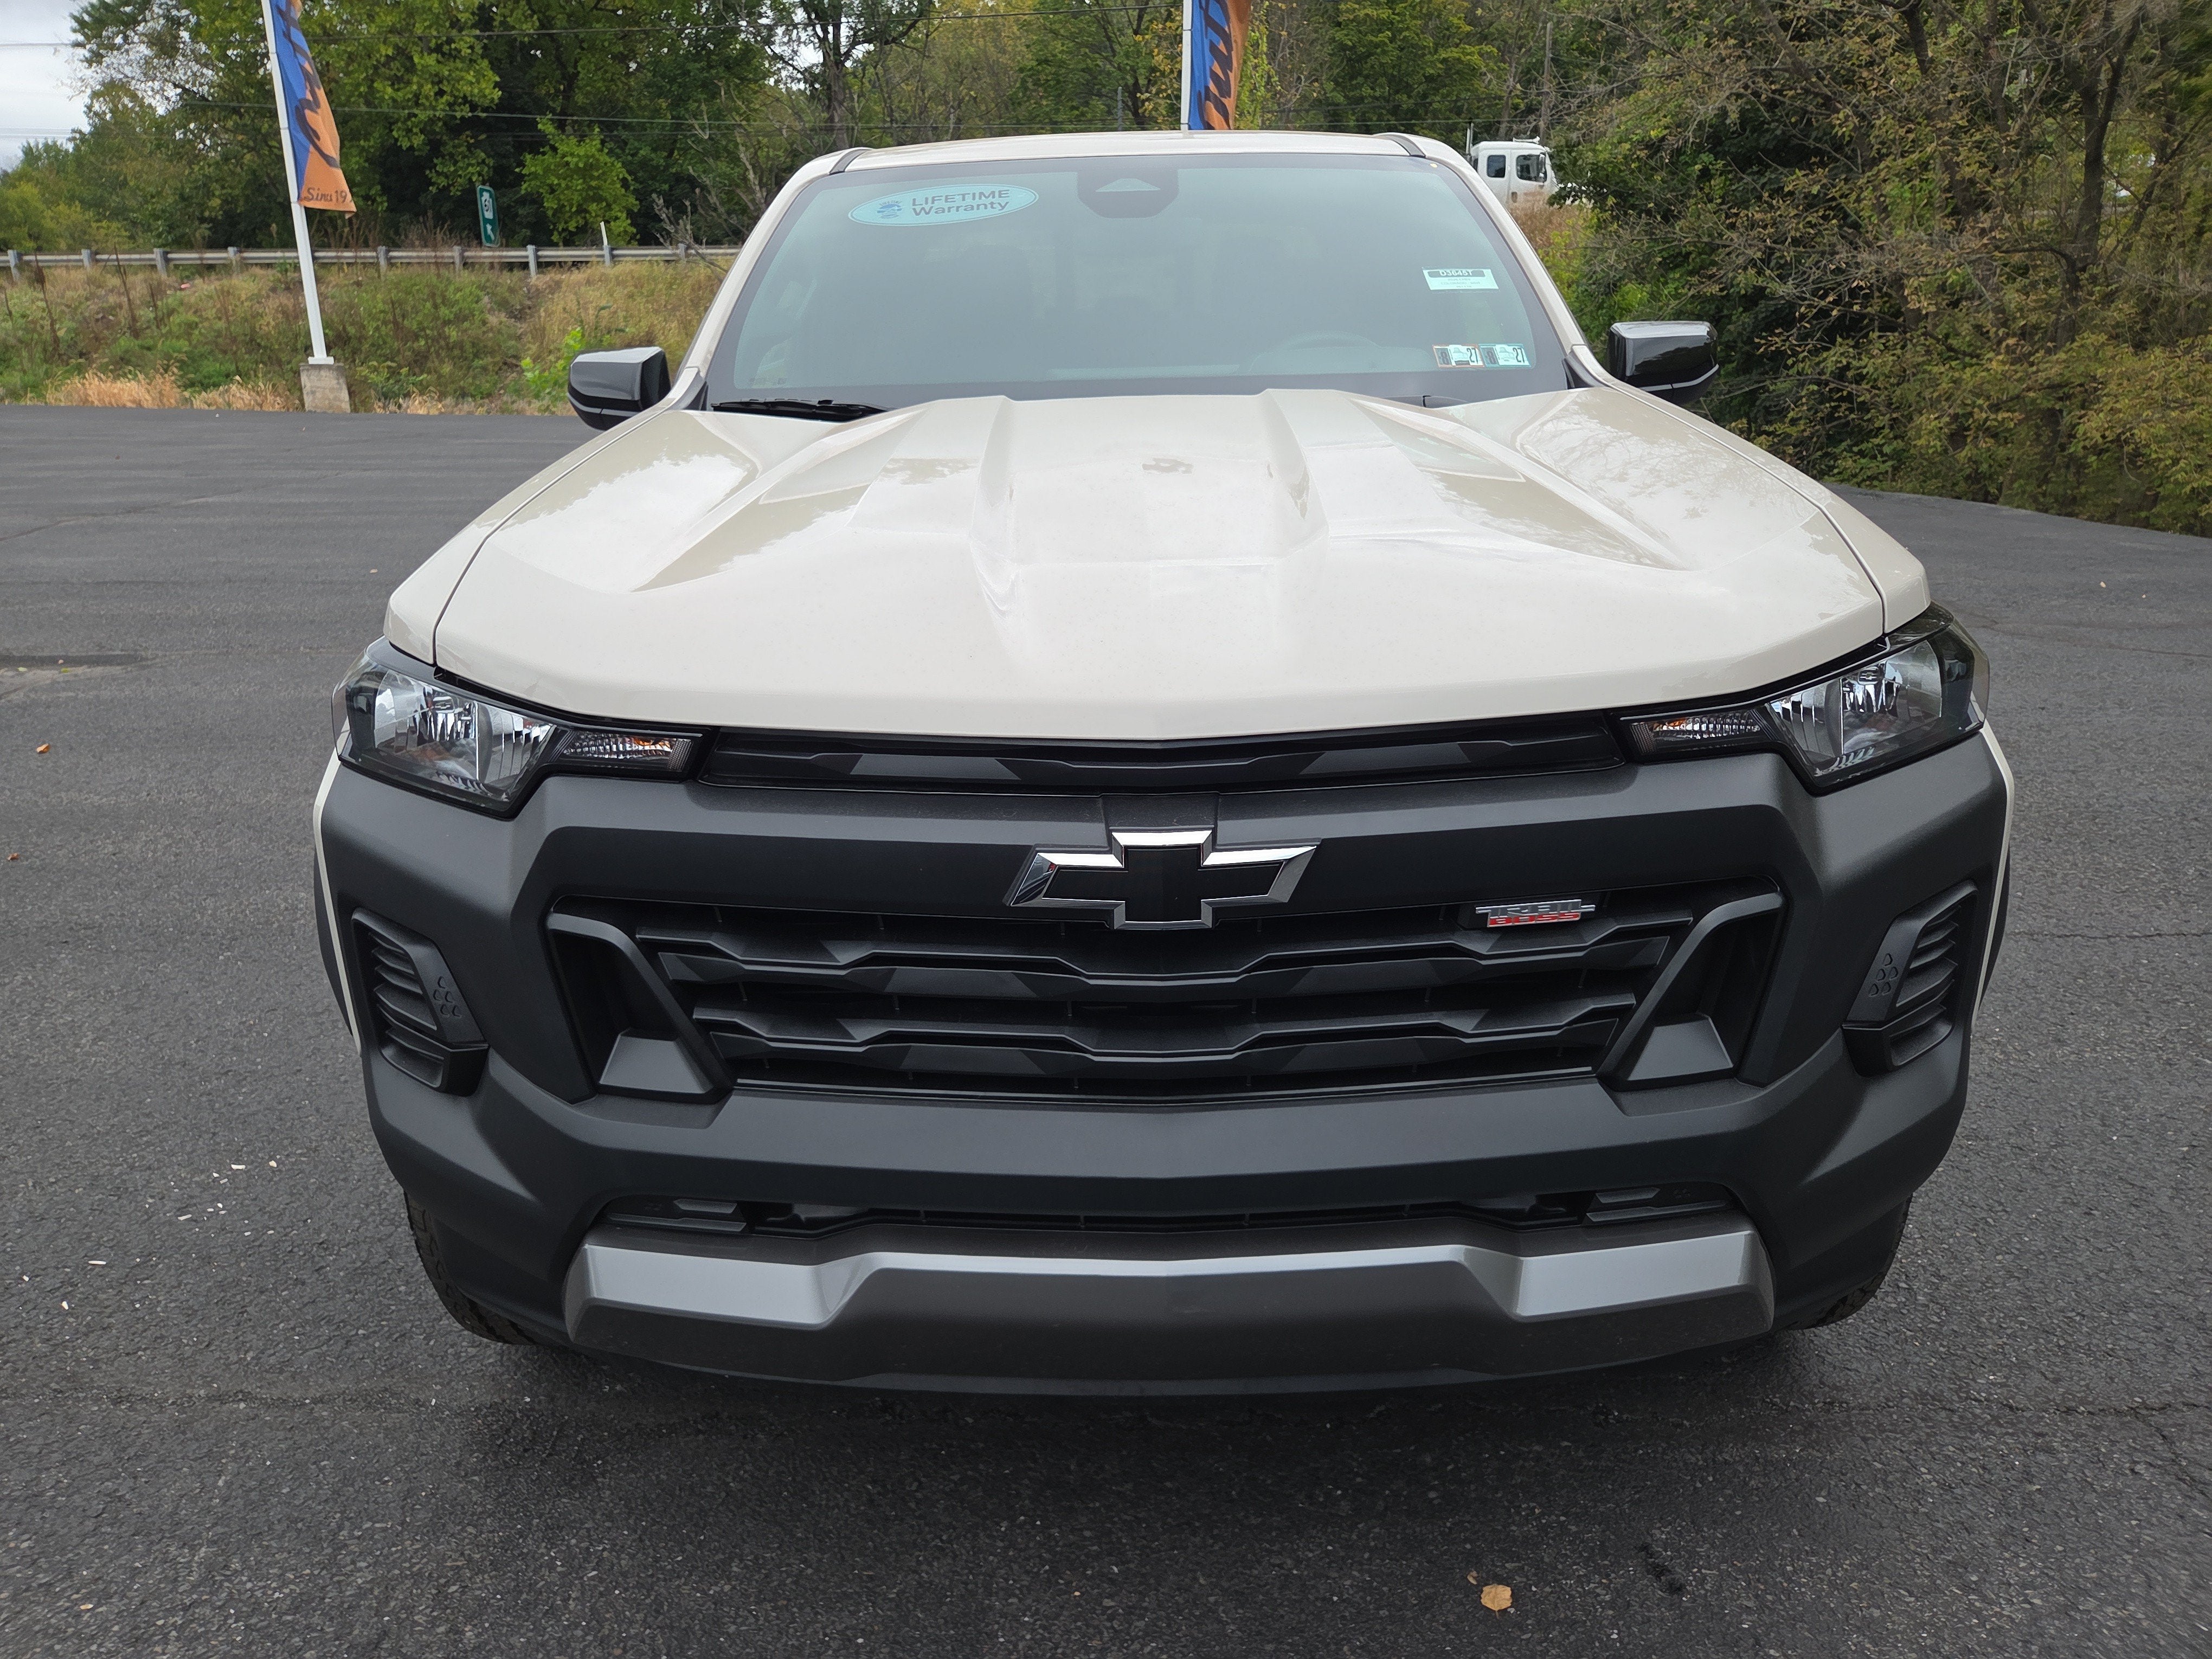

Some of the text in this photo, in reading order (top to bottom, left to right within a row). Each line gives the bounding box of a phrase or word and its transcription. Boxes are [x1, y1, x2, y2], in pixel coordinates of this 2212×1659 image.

[912, 189, 1010, 206] LIFETIME
[912, 201, 1010, 216] Warranty
[1467, 347, 1478, 364] 27
[1512, 347, 1525, 364] 27
[1488, 912, 1581, 928] BOSS
